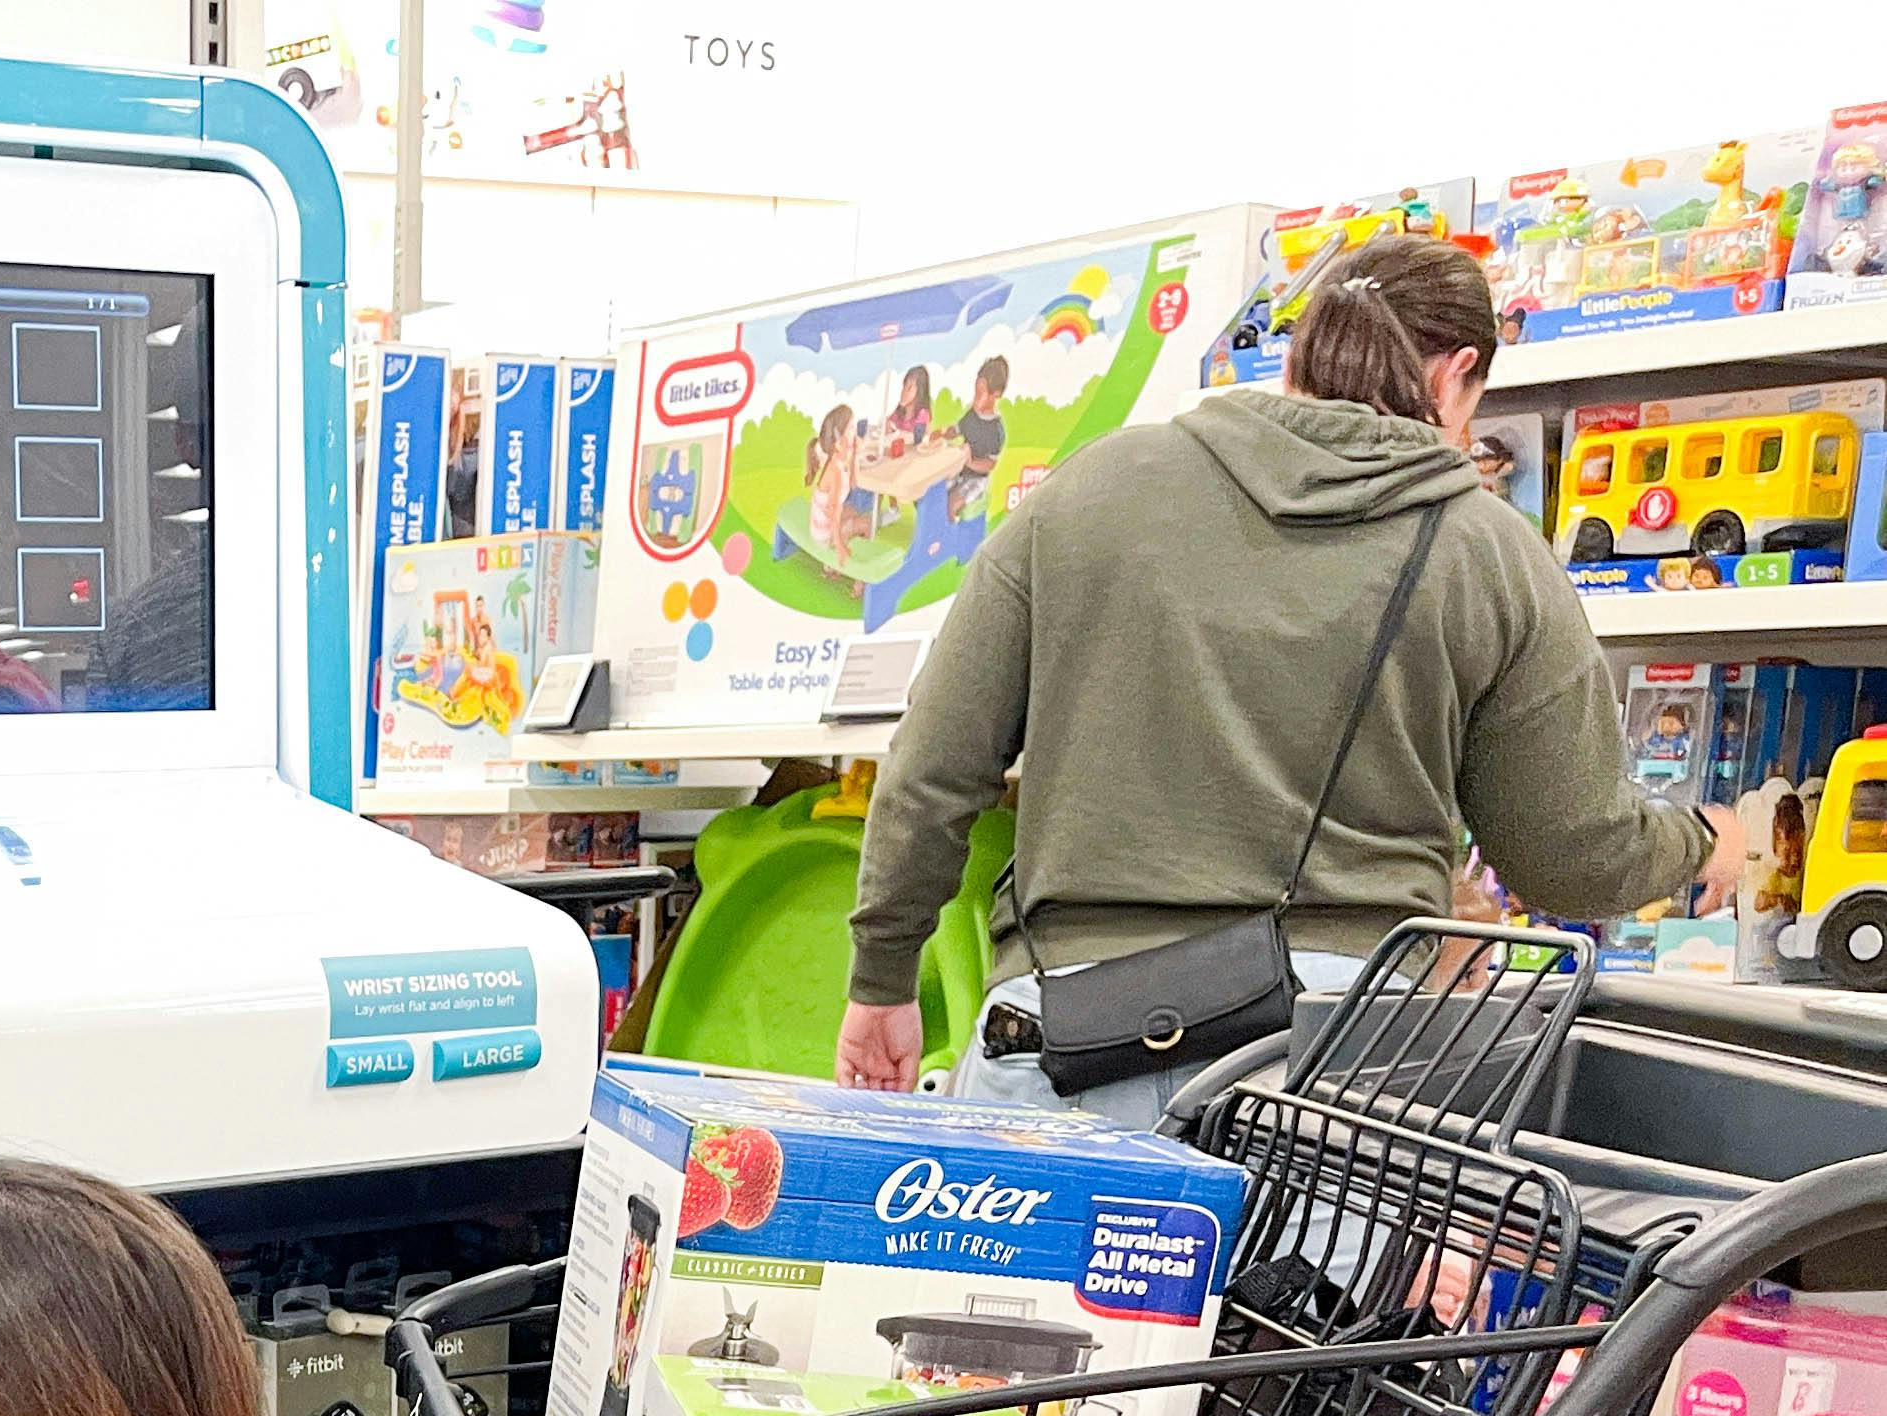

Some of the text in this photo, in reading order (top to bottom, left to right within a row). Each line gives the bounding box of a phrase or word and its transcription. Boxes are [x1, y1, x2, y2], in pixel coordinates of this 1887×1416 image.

[683, 34, 777, 72] TOYS
[669, 381, 702, 404] little
[391, 421, 411, 508] SPLASH
[505, 429, 524, 515] SPLASH
[580, 433, 597, 518] SPLASH
[1747, 564, 1779, 582] 1-5
[774, 641, 817, 668] Easy
[728, 673, 763, 692] Table
[766, 672, 785, 689] de
[343, 969, 523, 998] WRIST SIZING TOOL
[354, 994, 515, 1017] Lay wrist flat and align to left
[346, 1053, 408, 1075] SMALL
[462, 1044, 525, 1069] LARGE
[873, 1156, 1053, 1227] Oster
[1096, 1213, 1158, 1229] EXCLUSIVE
[884, 1230, 1016, 1266] MAKE IT FRESH
[1092, 1226, 1196, 1256] Duralast
[686, 1258, 807, 1281] CLASSIC SERIES
[1087, 1250, 1196, 1278] All Metal
[1084, 1271, 1149, 1296] Drive
[306, 1353, 344, 1376] fitbit
